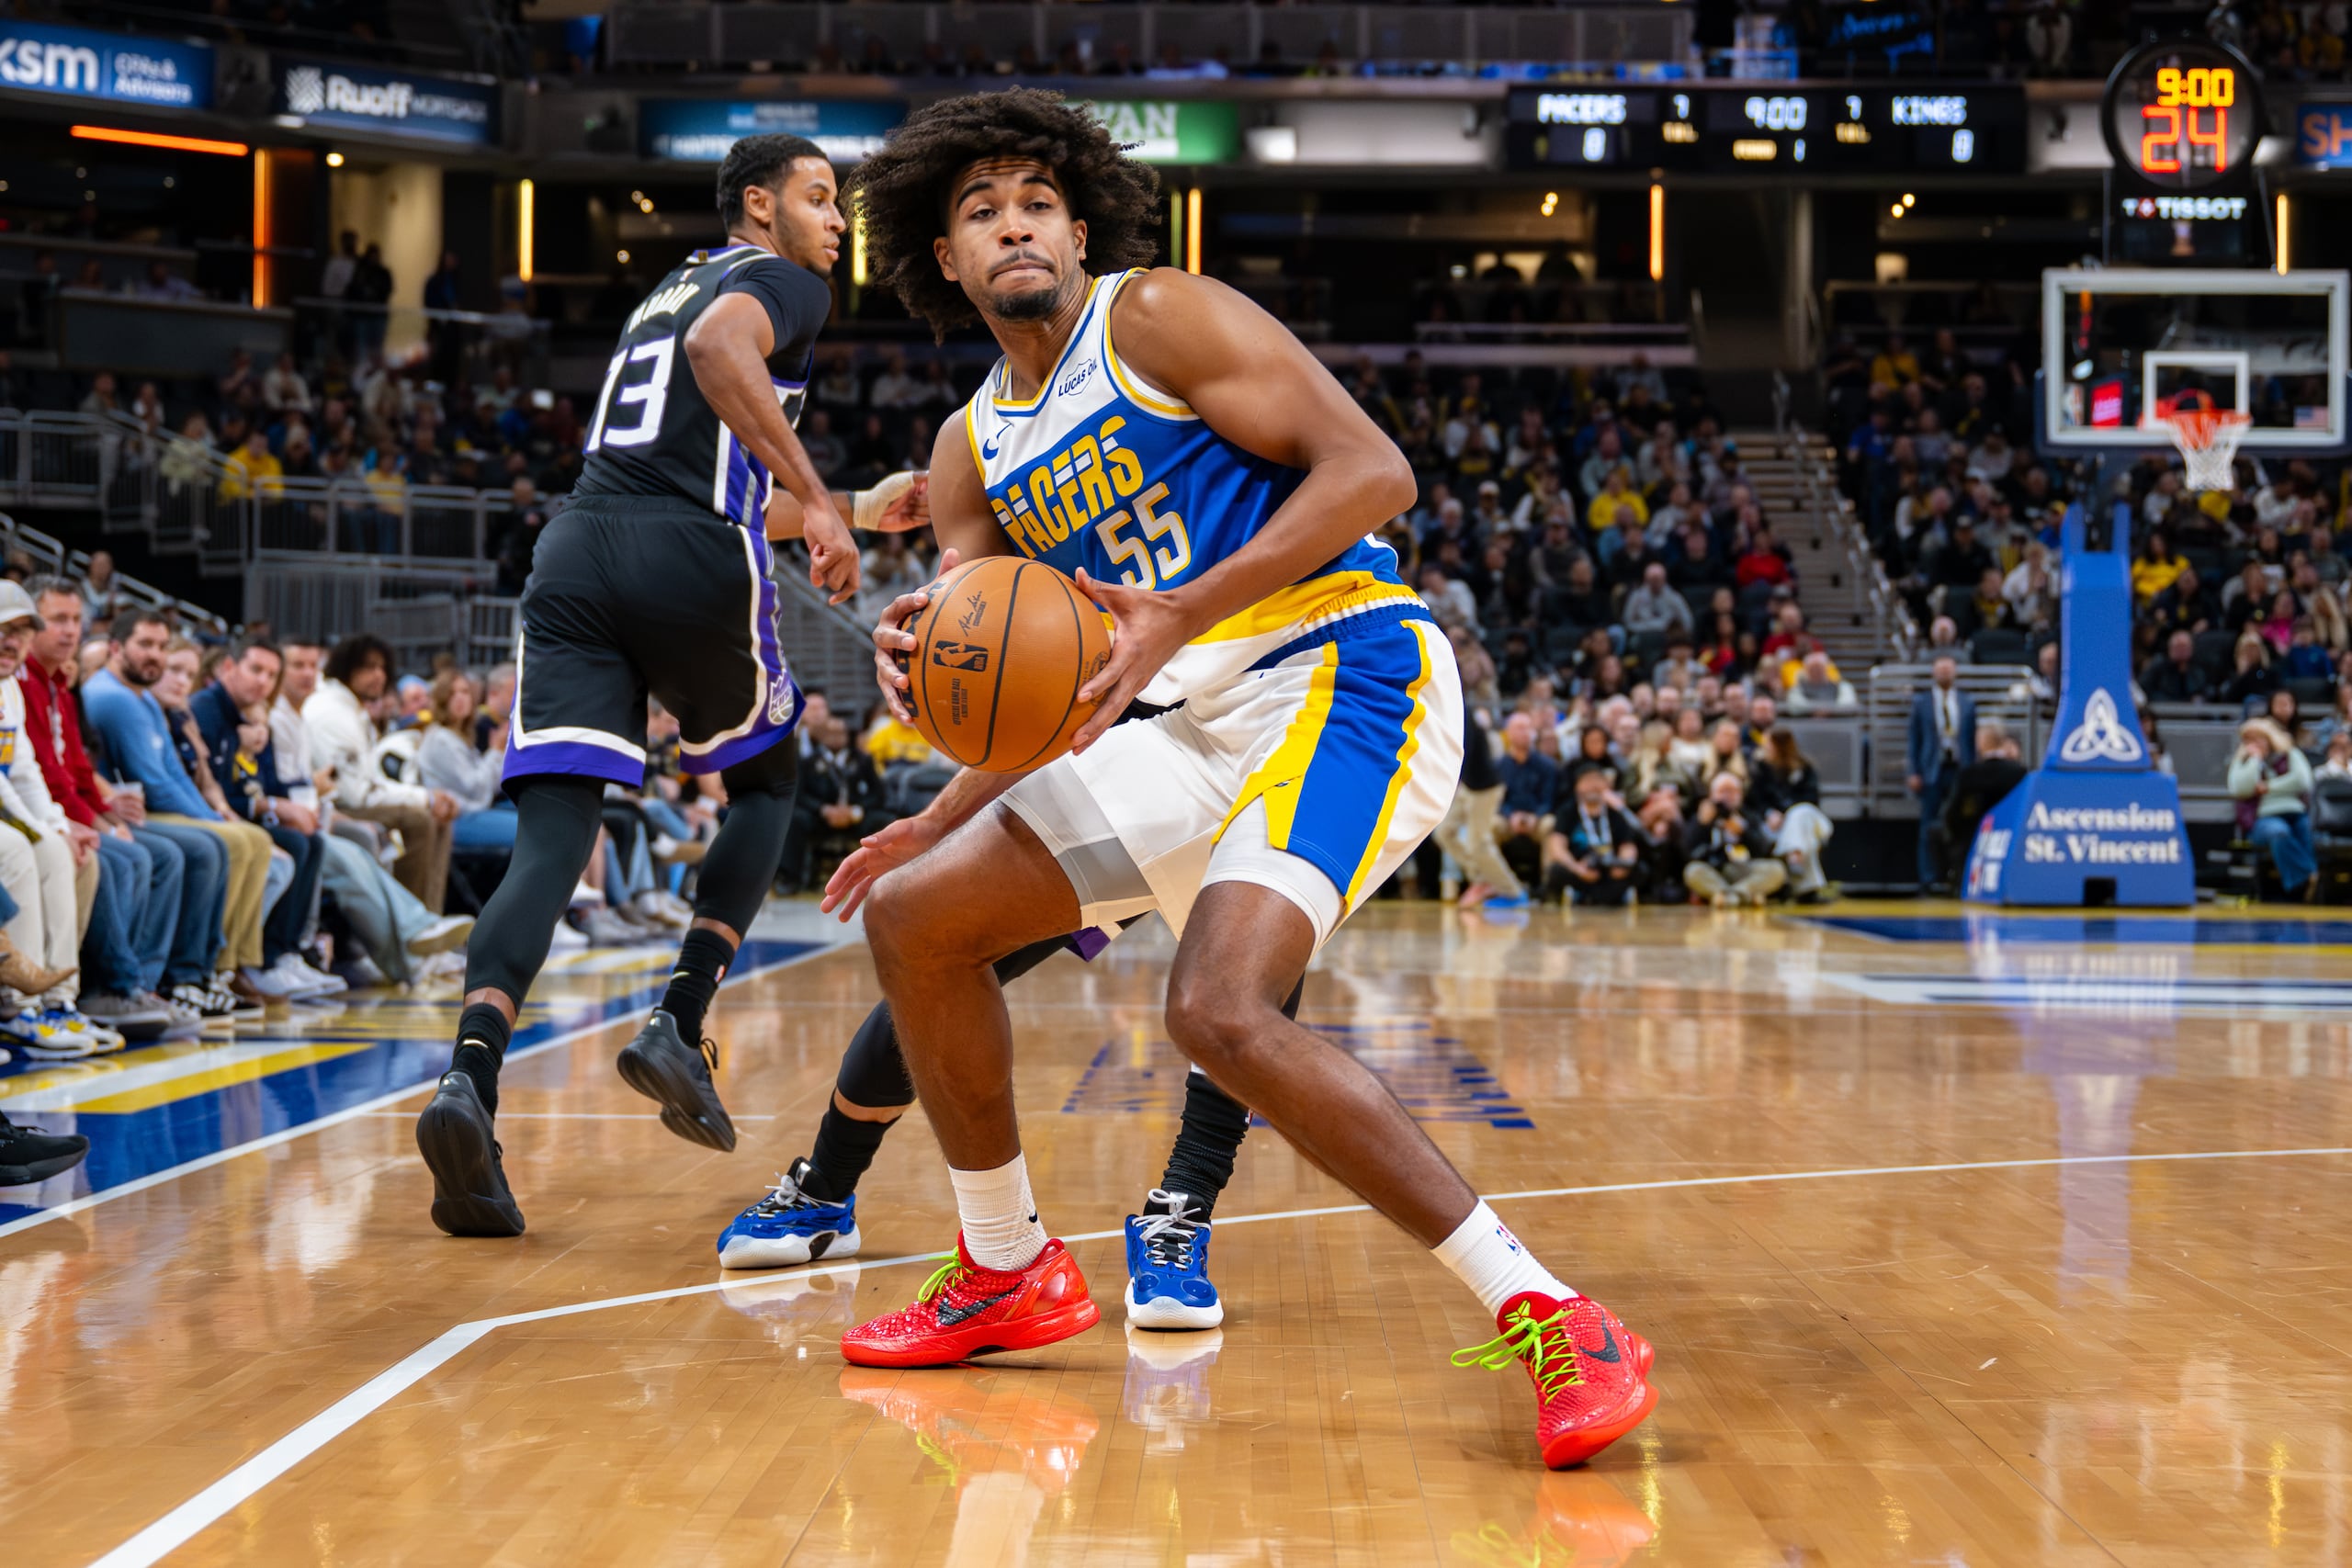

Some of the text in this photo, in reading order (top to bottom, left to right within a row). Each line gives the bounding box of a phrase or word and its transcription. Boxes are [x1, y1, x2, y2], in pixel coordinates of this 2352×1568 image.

[326, 74, 412, 118] Ruoff
[2156, 68, 2234, 107] 9:00
[1538, 94, 1626, 124] PACERS
[1892, 96, 1967, 125] KINGS
[2142, 105, 2227, 173] 24
[2155, 197, 2247, 220] TISSOT
[582, 333, 676, 455] 13
[1058, 369, 1086, 397] LUCAS
[990, 415, 1144, 559] PACERS
[1094, 481, 1192, 591] 55
[2028, 801, 2176, 831] Ascension
[2024, 833, 2180, 863] St. Vincent
